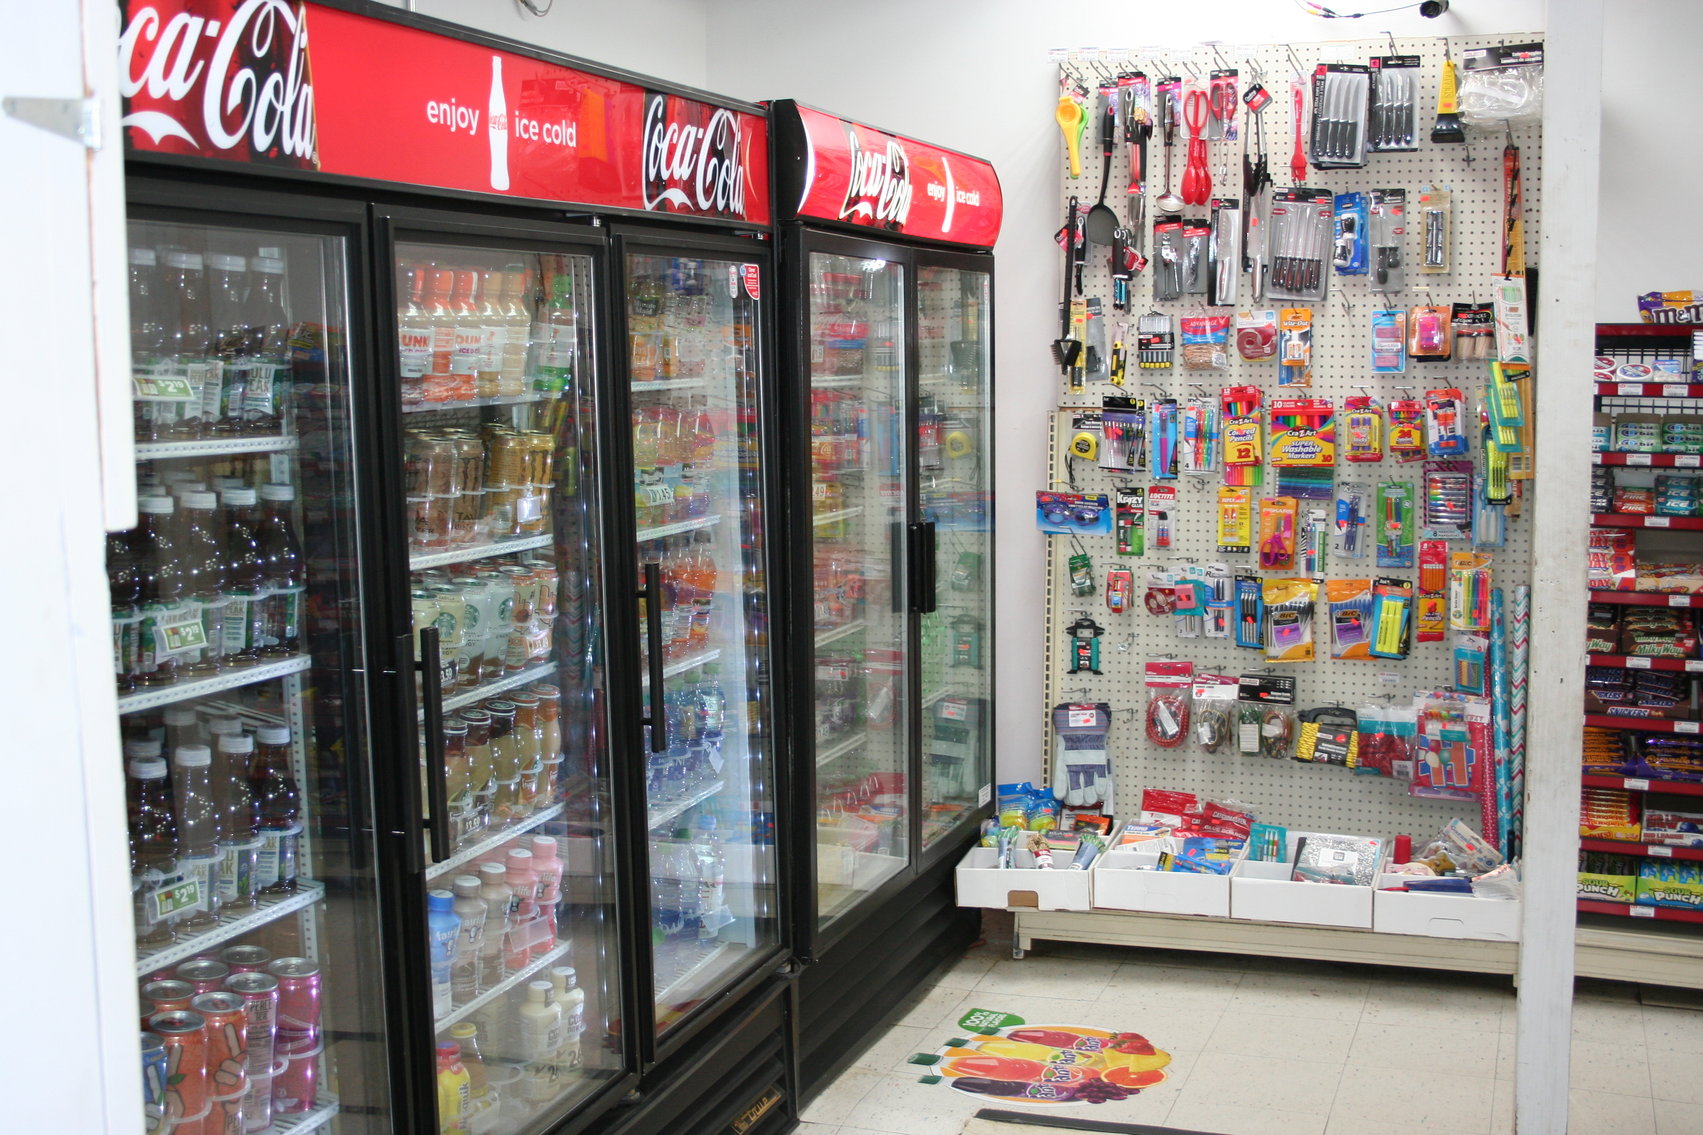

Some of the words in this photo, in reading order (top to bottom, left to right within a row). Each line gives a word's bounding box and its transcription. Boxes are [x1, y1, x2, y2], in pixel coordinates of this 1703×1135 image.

[120, 0, 317, 158] ca-Cola
[427, 98, 480, 136] enjoy
[515, 110, 539, 142] ice
[542, 122, 577, 148] cold
[642, 94, 745, 216] Coca-Cola
[839, 131, 913, 223] Coca-Cola
[927, 182, 946, 202] enjoy
[955, 186, 966, 204] ice
[966, 191, 980, 206] cold
[1228, 435, 1254, 443] Pencils
[1398, 430, 1412, 438] 24
[1236, 448, 1251, 459] 12
[1281, 445, 1322, 454] Washable
[1287, 452, 1316, 460] Markers
[1322, 454, 1333, 463] 10
[1666, 500, 1690, 508] ICE
[1432, 530, 1438, 538] 8
[1591, 639, 1614, 651] Way
[1637, 644, 1663, 656] Milky
[1662, 645, 1684, 655] Way
[1608, 707, 1650, 716] SNICKERS
[1204, 824, 1221, 833] GLUE
[1577, 883, 1620, 897] PUNCH
[1664, 887, 1692, 895] SOUR
[1654, 891, 1702, 905] PUNCH
[568, 1014, 583, 1026] COR
[963, 1011, 990, 1027] 100%
